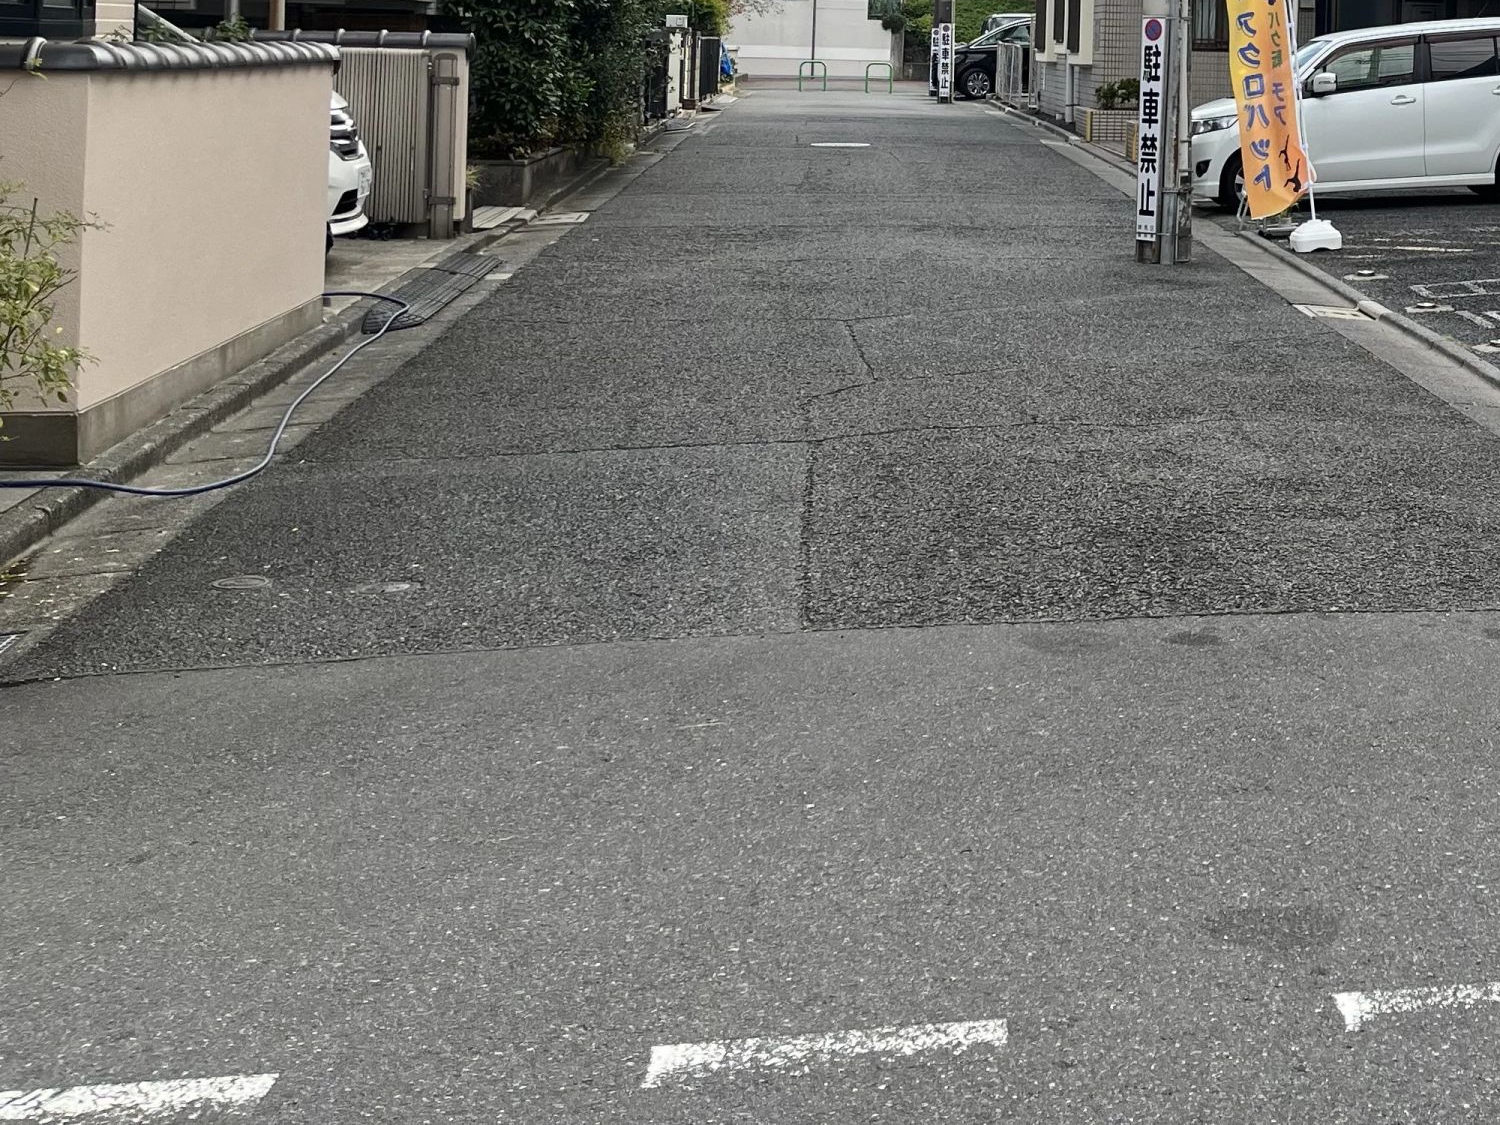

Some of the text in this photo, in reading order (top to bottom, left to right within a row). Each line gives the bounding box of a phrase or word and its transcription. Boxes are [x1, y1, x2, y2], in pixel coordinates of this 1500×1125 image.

[941, 33, 950, 89] 駐車禁止
[1138, 44, 1162, 217] 駐車禁止
